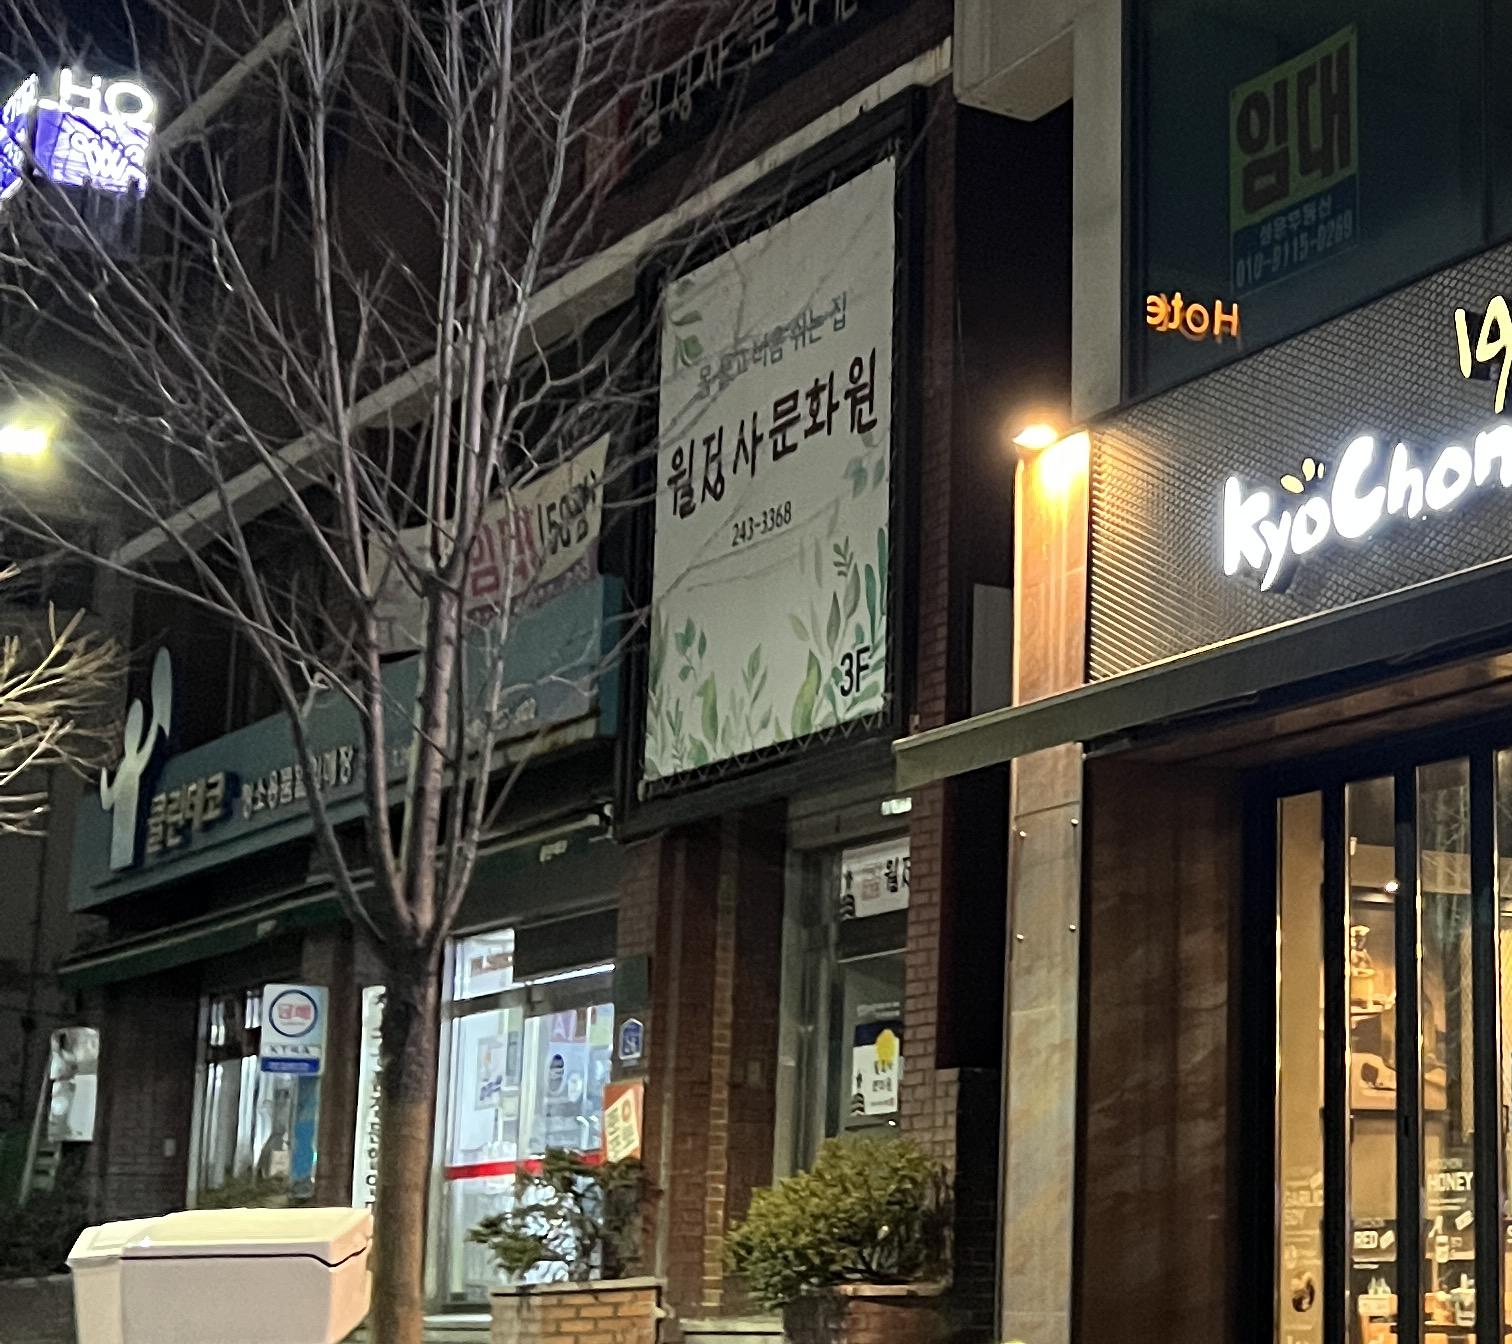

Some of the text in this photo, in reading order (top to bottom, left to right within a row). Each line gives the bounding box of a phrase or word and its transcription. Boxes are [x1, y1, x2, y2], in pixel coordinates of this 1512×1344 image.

[1236, 53, 1351, 214] 임대
[666, 348, 878, 519] 월정사문화원
[731, 500, 793, 547] 243-3368
[839, 647, 871, 697] 3F
[1427, 1171, 1473, 1192] HONEY
